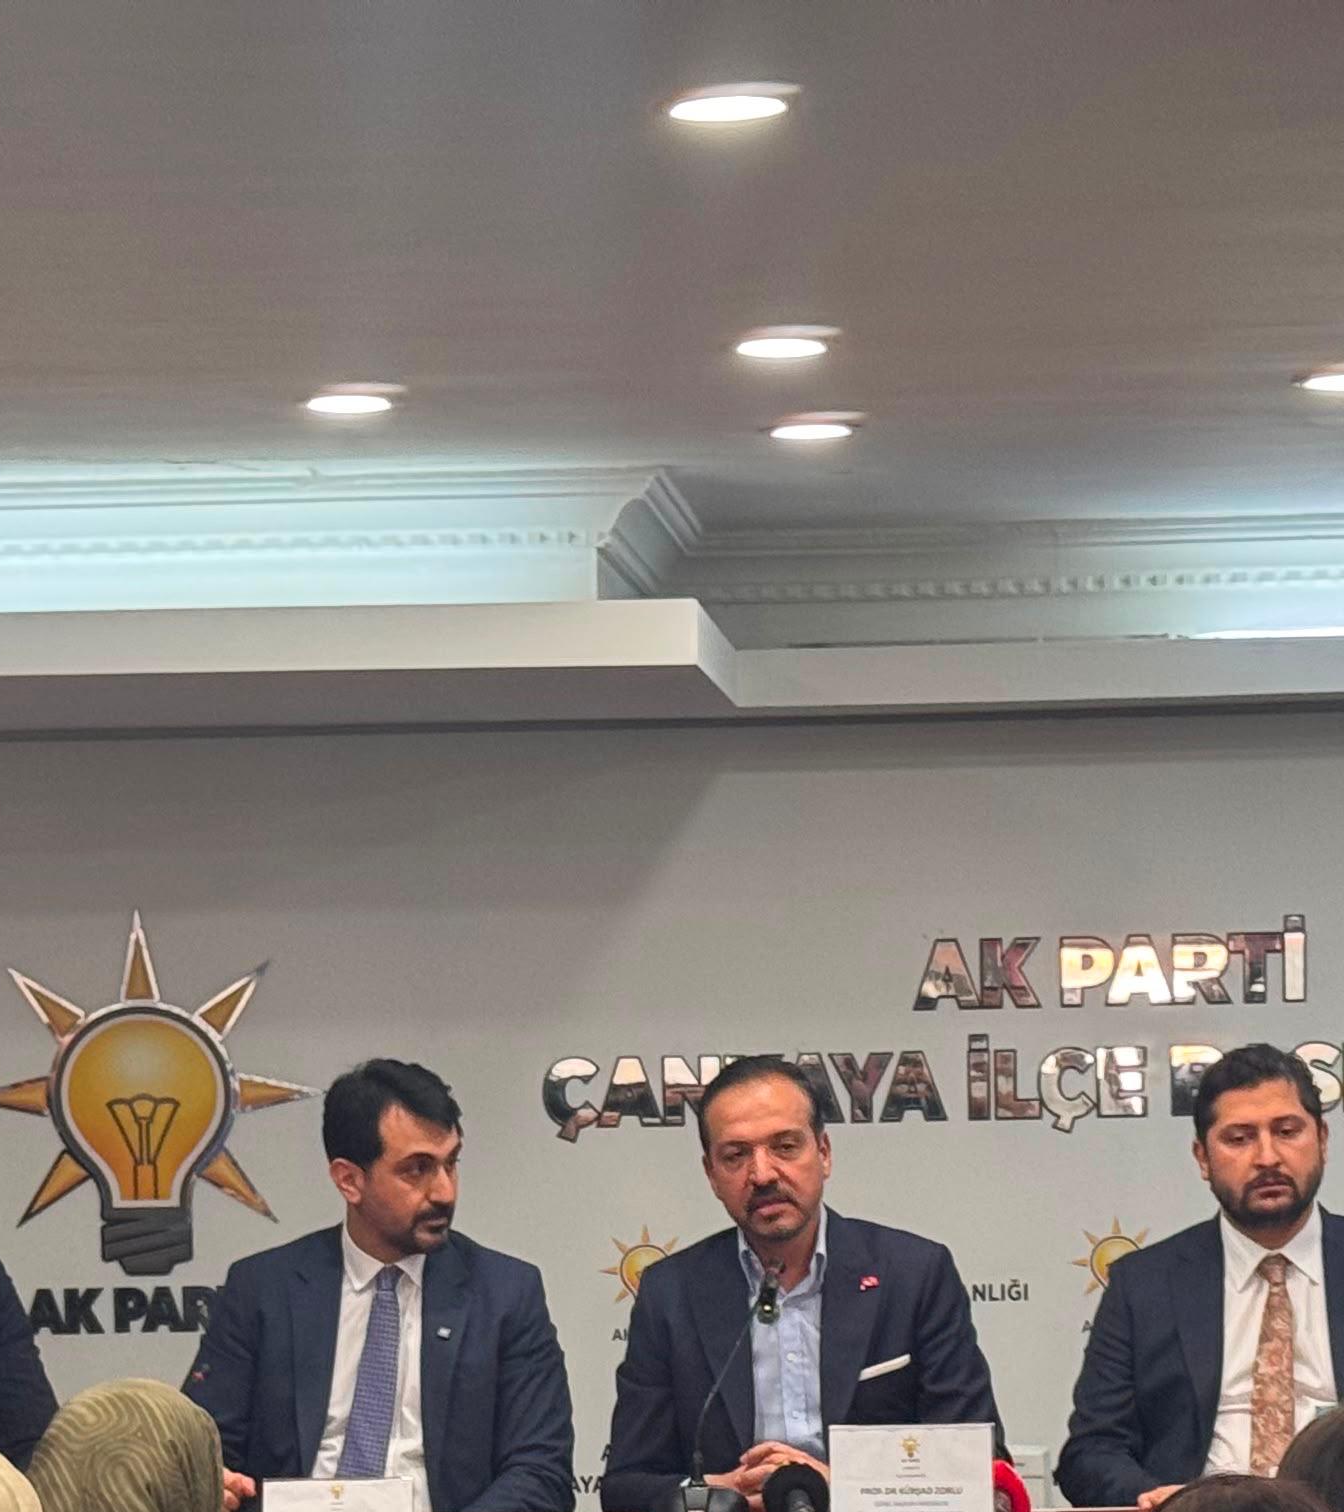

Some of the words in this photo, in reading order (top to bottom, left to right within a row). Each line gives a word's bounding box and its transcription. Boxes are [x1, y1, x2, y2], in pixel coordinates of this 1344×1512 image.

[912, 936, 1043, 1011] AK
[1059, 914, 1307, 1008] PARTİ
[542, 1050, 949, 1143] ÇANAYA
[966, 1033, 1149, 1133] İLÇE
[29, 1287, 105, 1335] AK
[113, 1285, 225, 1333] PAR
